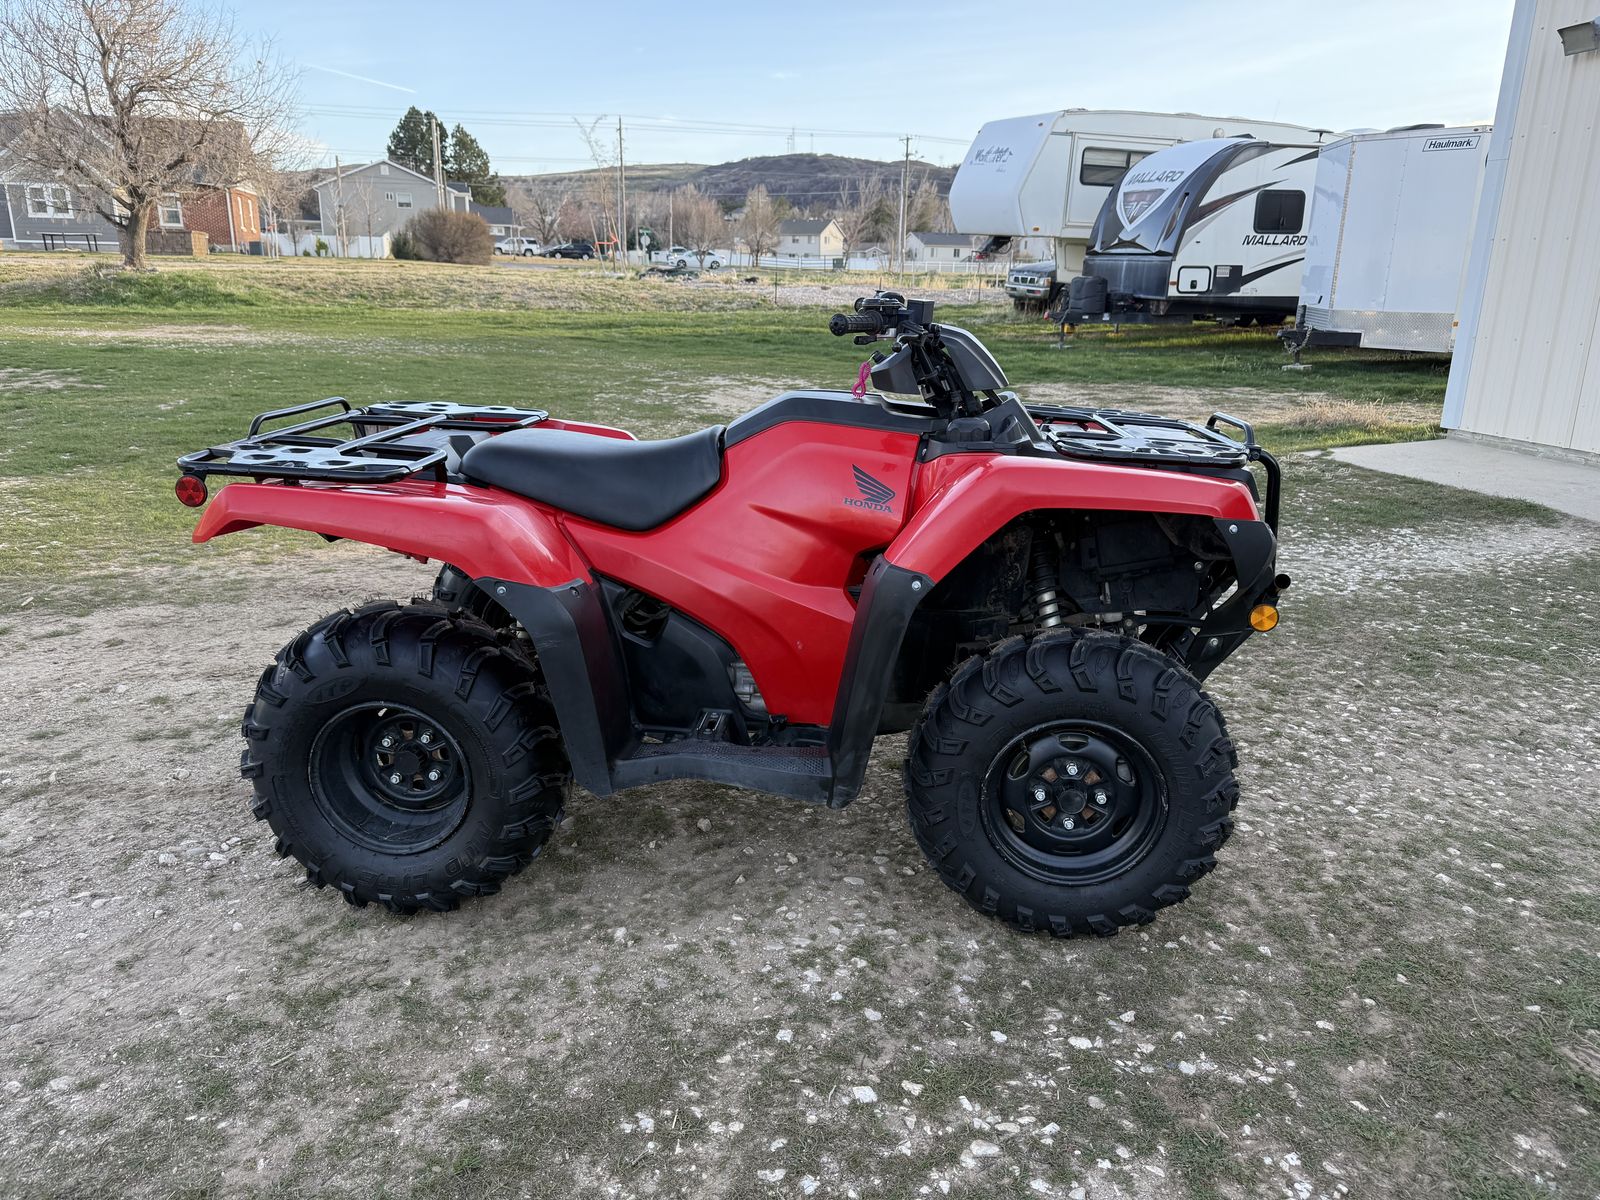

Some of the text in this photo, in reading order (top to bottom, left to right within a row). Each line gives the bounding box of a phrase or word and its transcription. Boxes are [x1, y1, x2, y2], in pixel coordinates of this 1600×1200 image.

[1428, 138, 1472, 149] Haulmark
[1125, 171, 1184, 186] MALLARD
[1242, 234, 1308, 246] MALLARD
[844, 497, 893, 513] HONDA
